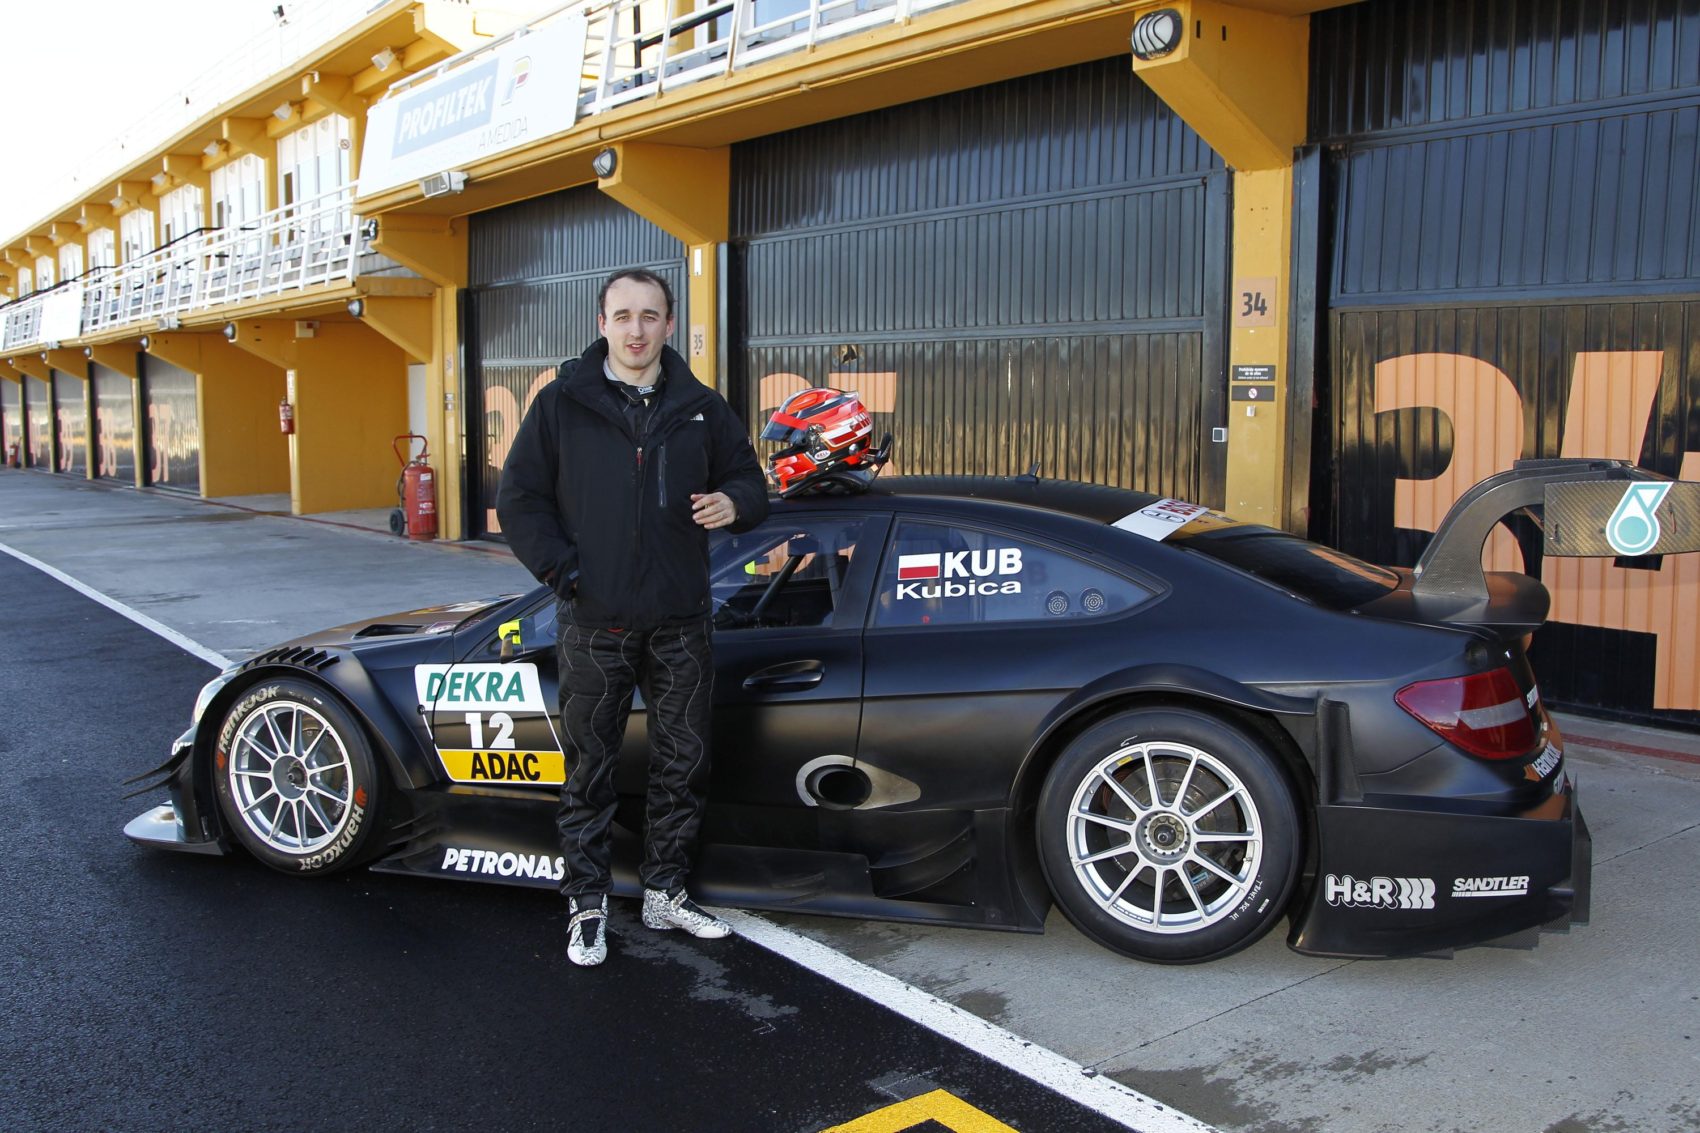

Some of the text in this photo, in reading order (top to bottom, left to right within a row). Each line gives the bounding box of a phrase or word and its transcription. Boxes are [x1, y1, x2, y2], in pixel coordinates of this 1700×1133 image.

[398, 75, 493, 143] PROFILTEK
[488, 116, 529, 146] MEDIDA
[1242, 292, 1267, 316] 34
[694, 334, 703, 350] 35
[149, 403, 174, 483] 37
[944, 548, 1023, 578] KUB
[896, 580, 1021, 600] Kubica
[426, 671, 525, 702] DEKRA
[465, 712, 515, 749] 12
[471, 753, 540, 781] ADAC
[441, 848, 565, 880] PETRONAS
[1325, 874, 1398, 909] H&R
[1453, 876, 1529, 891] SANDTLER
